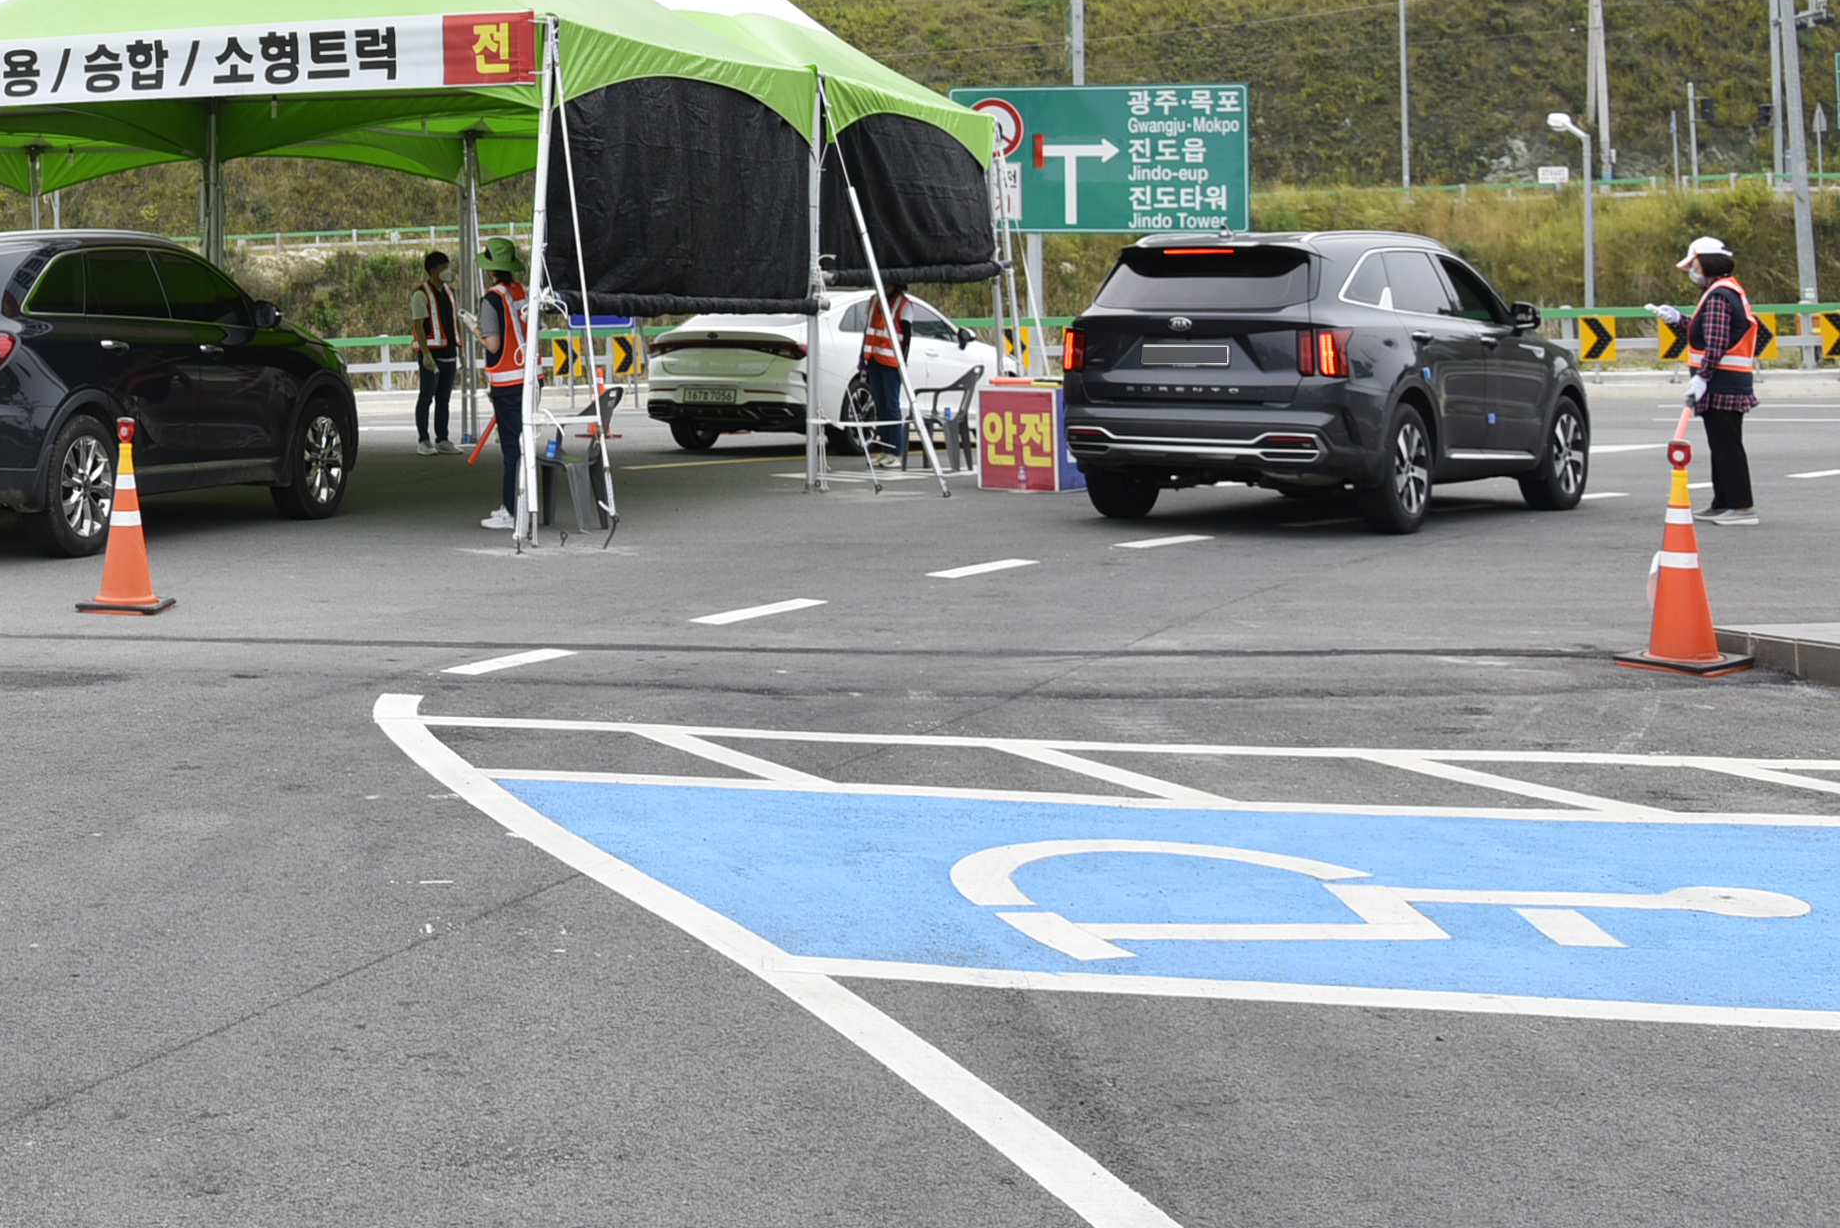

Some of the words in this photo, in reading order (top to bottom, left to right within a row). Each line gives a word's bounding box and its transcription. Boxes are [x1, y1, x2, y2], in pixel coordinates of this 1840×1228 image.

[213, 26, 396, 84] 소형트럭
[472, 22, 510, 74] 전
[1128, 138, 1207, 163] 진도읍
[1127, 165, 1209, 184] Jindo-eup
[1128, 185, 1227, 211] 진도타워
[1128, 213, 1173, 228] Jindo
[1176, 213, 1227, 228] Tower
[1126, 385, 1239, 394] SORENTO
[983, 411, 1052, 467] 안전
